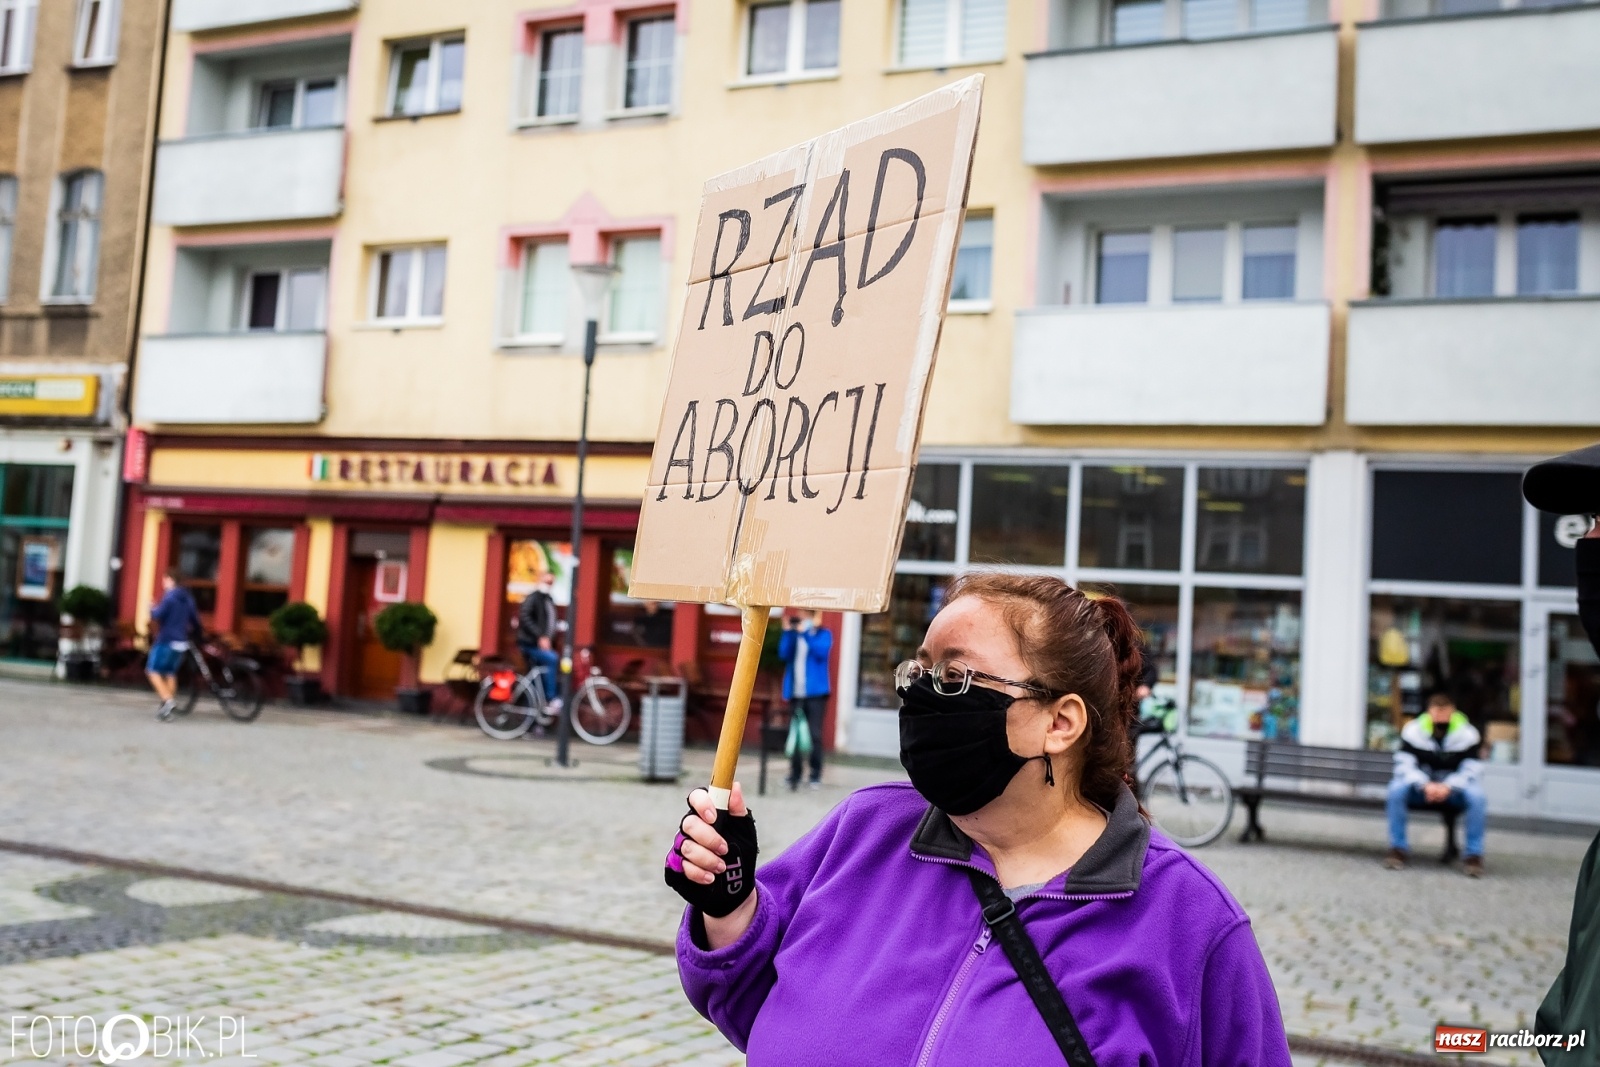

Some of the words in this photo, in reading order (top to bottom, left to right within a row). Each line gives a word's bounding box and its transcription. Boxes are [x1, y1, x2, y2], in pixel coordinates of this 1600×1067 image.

[697, 147, 926, 331] RZĄD
[742, 321, 806, 397] DO
[656, 383, 887, 515] ABORCJI
[726, 856, 743, 895] GEL
